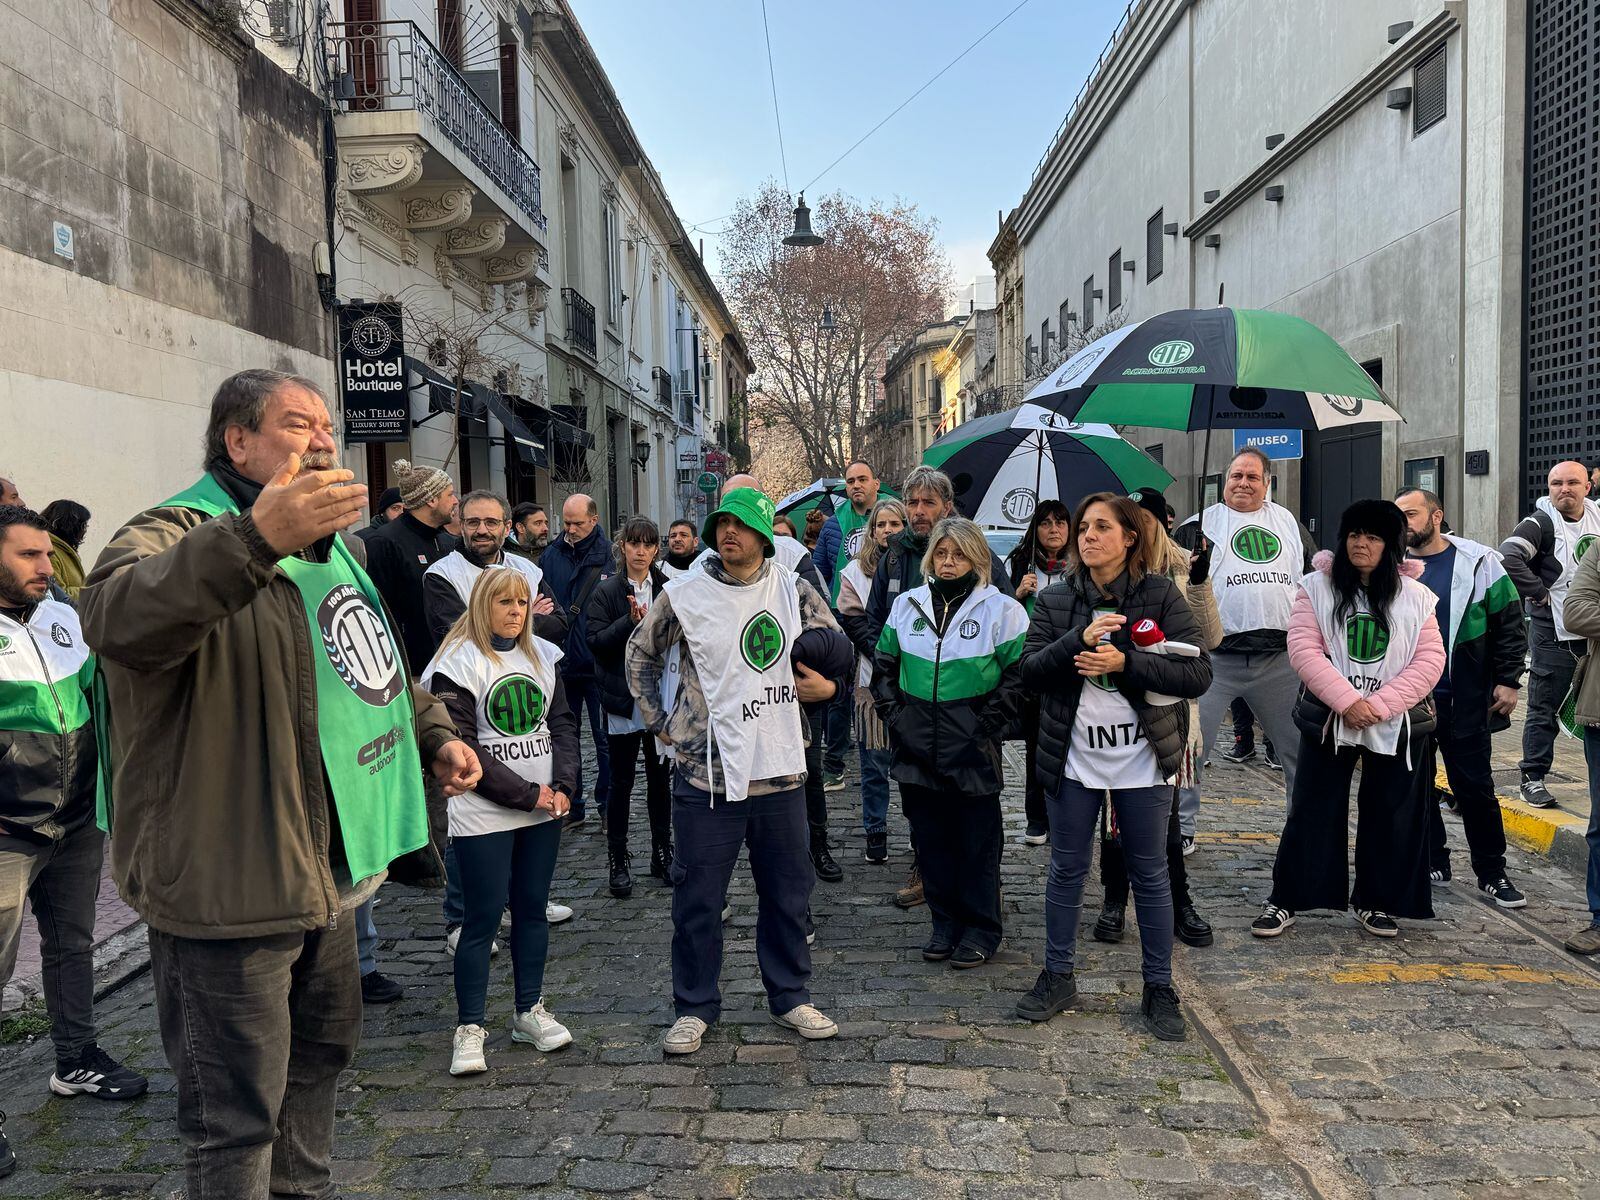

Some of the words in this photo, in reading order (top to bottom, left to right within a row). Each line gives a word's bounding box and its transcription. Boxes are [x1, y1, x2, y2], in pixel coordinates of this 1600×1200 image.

[1153, 342, 1190, 365] ATE
[346, 357, 403, 378] Hotel
[347, 378, 403, 392] Boutique
[346, 408, 366, 418] SAN
[369, 408, 405, 418] TELMO
[351, 421, 377, 429] LUXURY
[1247, 435, 1288, 446] MUSEO
[1236, 528, 1278, 561] ATE
[1226, 571, 1293, 588] AGRICULTURA
[327, 591, 342, 609] 100
[340, 586, 358, 598] AÑO
[336, 605, 394, 682] ATE
[492, 680, 541, 732] ATE
[1087, 721, 1149, 749] INTA
